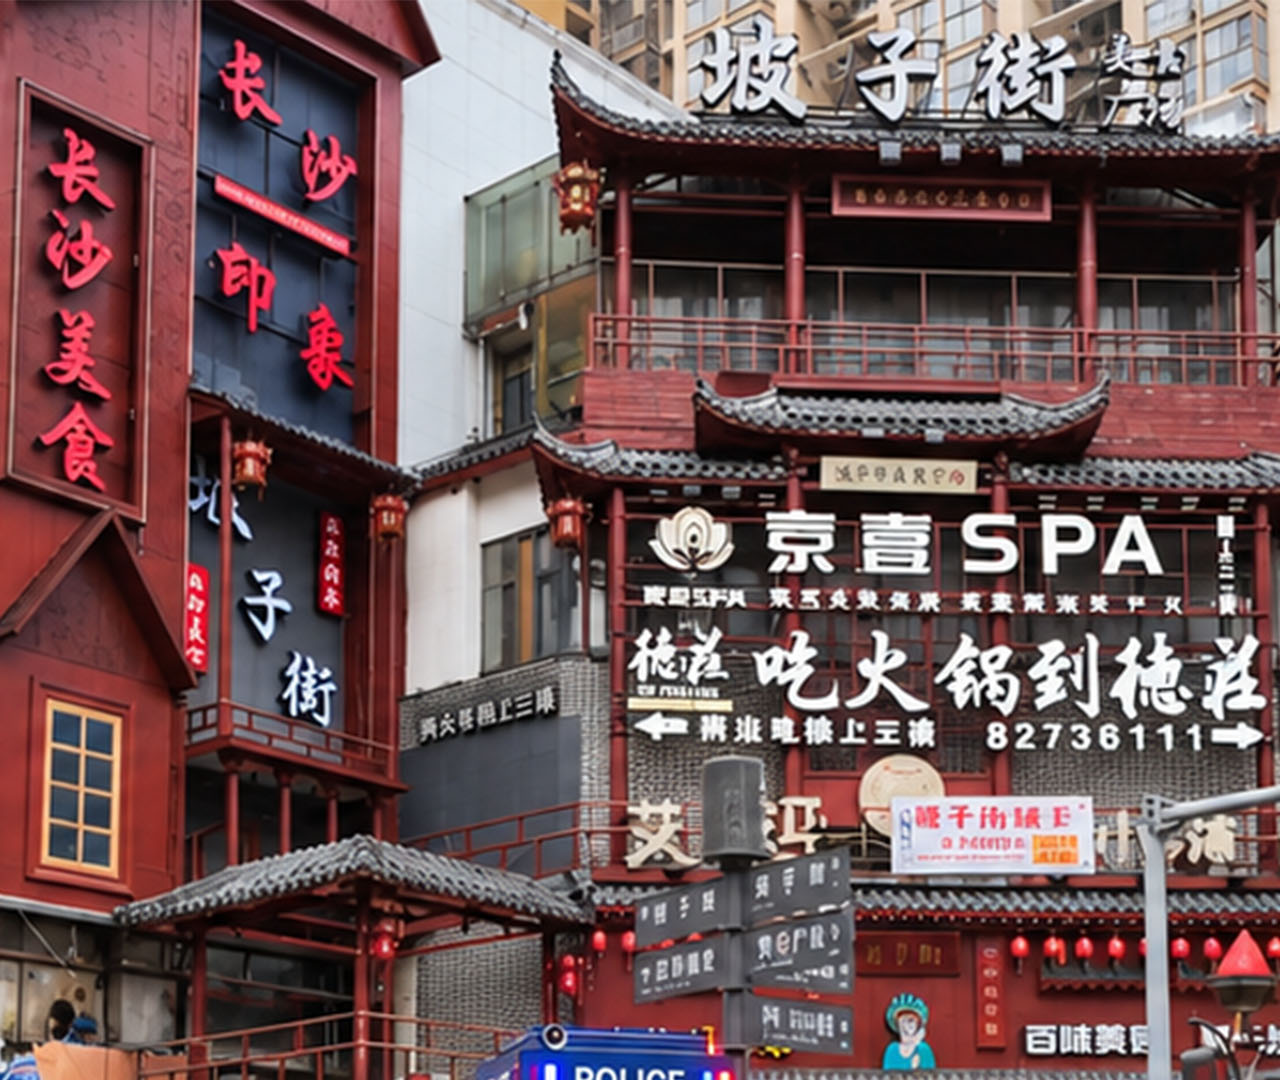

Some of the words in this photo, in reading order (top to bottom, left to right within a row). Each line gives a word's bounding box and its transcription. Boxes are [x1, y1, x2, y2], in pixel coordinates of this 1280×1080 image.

[221, 40, 357, 200] 长沙
[699, 20, 1076, 122] 坡子街
[38, 128, 116, 492] 长沙美食
[216, 243, 355, 391] 印象
[985, 719, 1204, 753] 82736111
